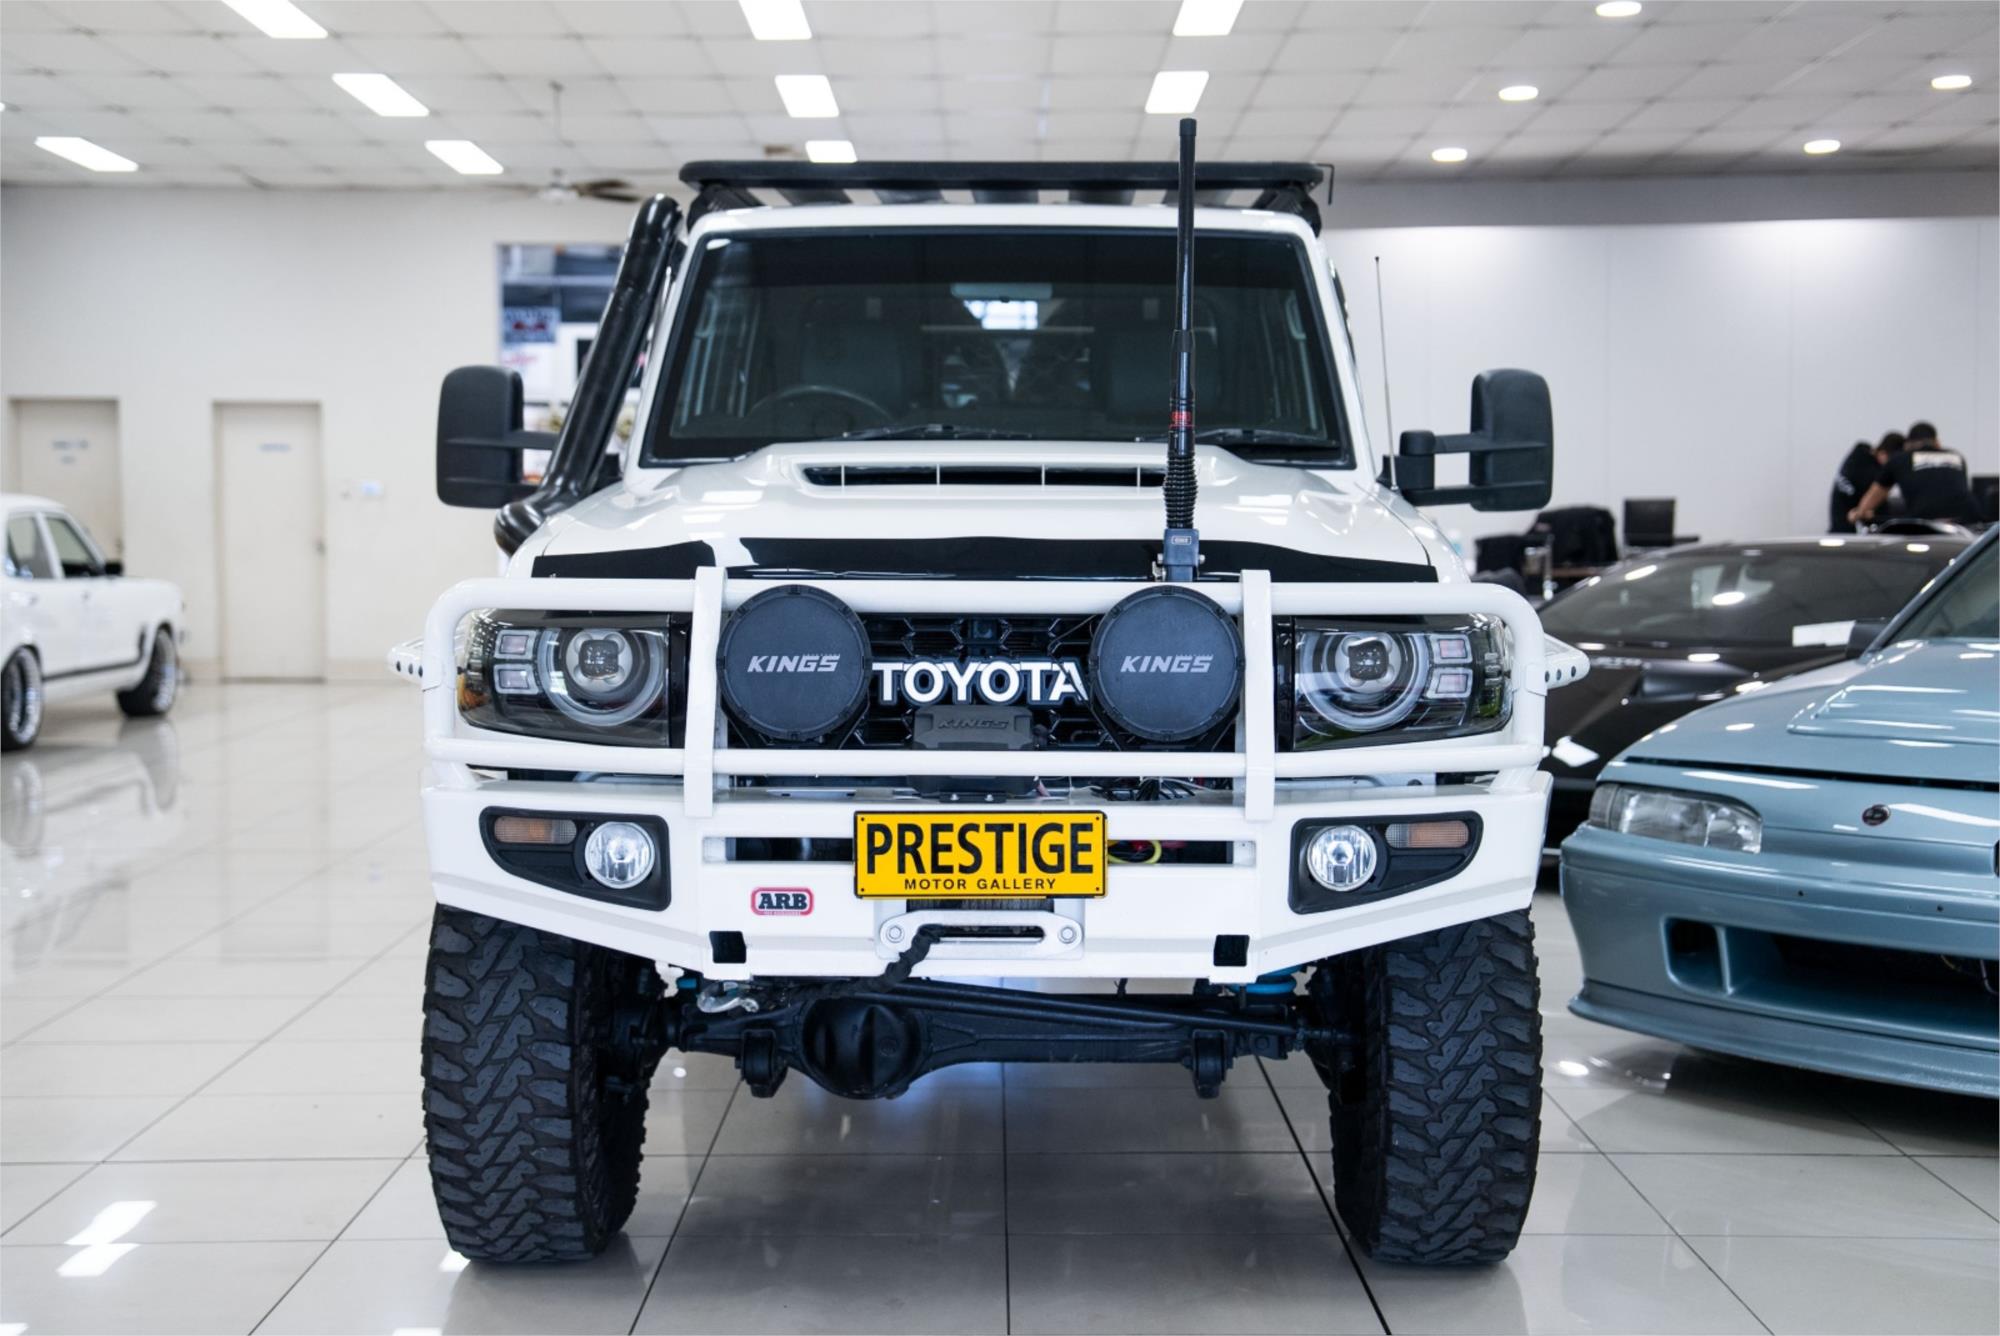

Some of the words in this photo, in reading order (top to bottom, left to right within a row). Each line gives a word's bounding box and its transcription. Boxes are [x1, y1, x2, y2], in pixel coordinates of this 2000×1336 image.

[747, 654, 840, 673] KINGS
[1120, 654, 1214, 673] KINGS
[872, 661, 1089, 702] TOYOTA
[938, 718, 1009, 730] KINGS
[866, 822, 1094, 874] PRESTIGE
[904, 878, 967, 890] MOTOR
[977, 878, 1056, 890] GALLERY
[758, 893, 808, 910] ARB
